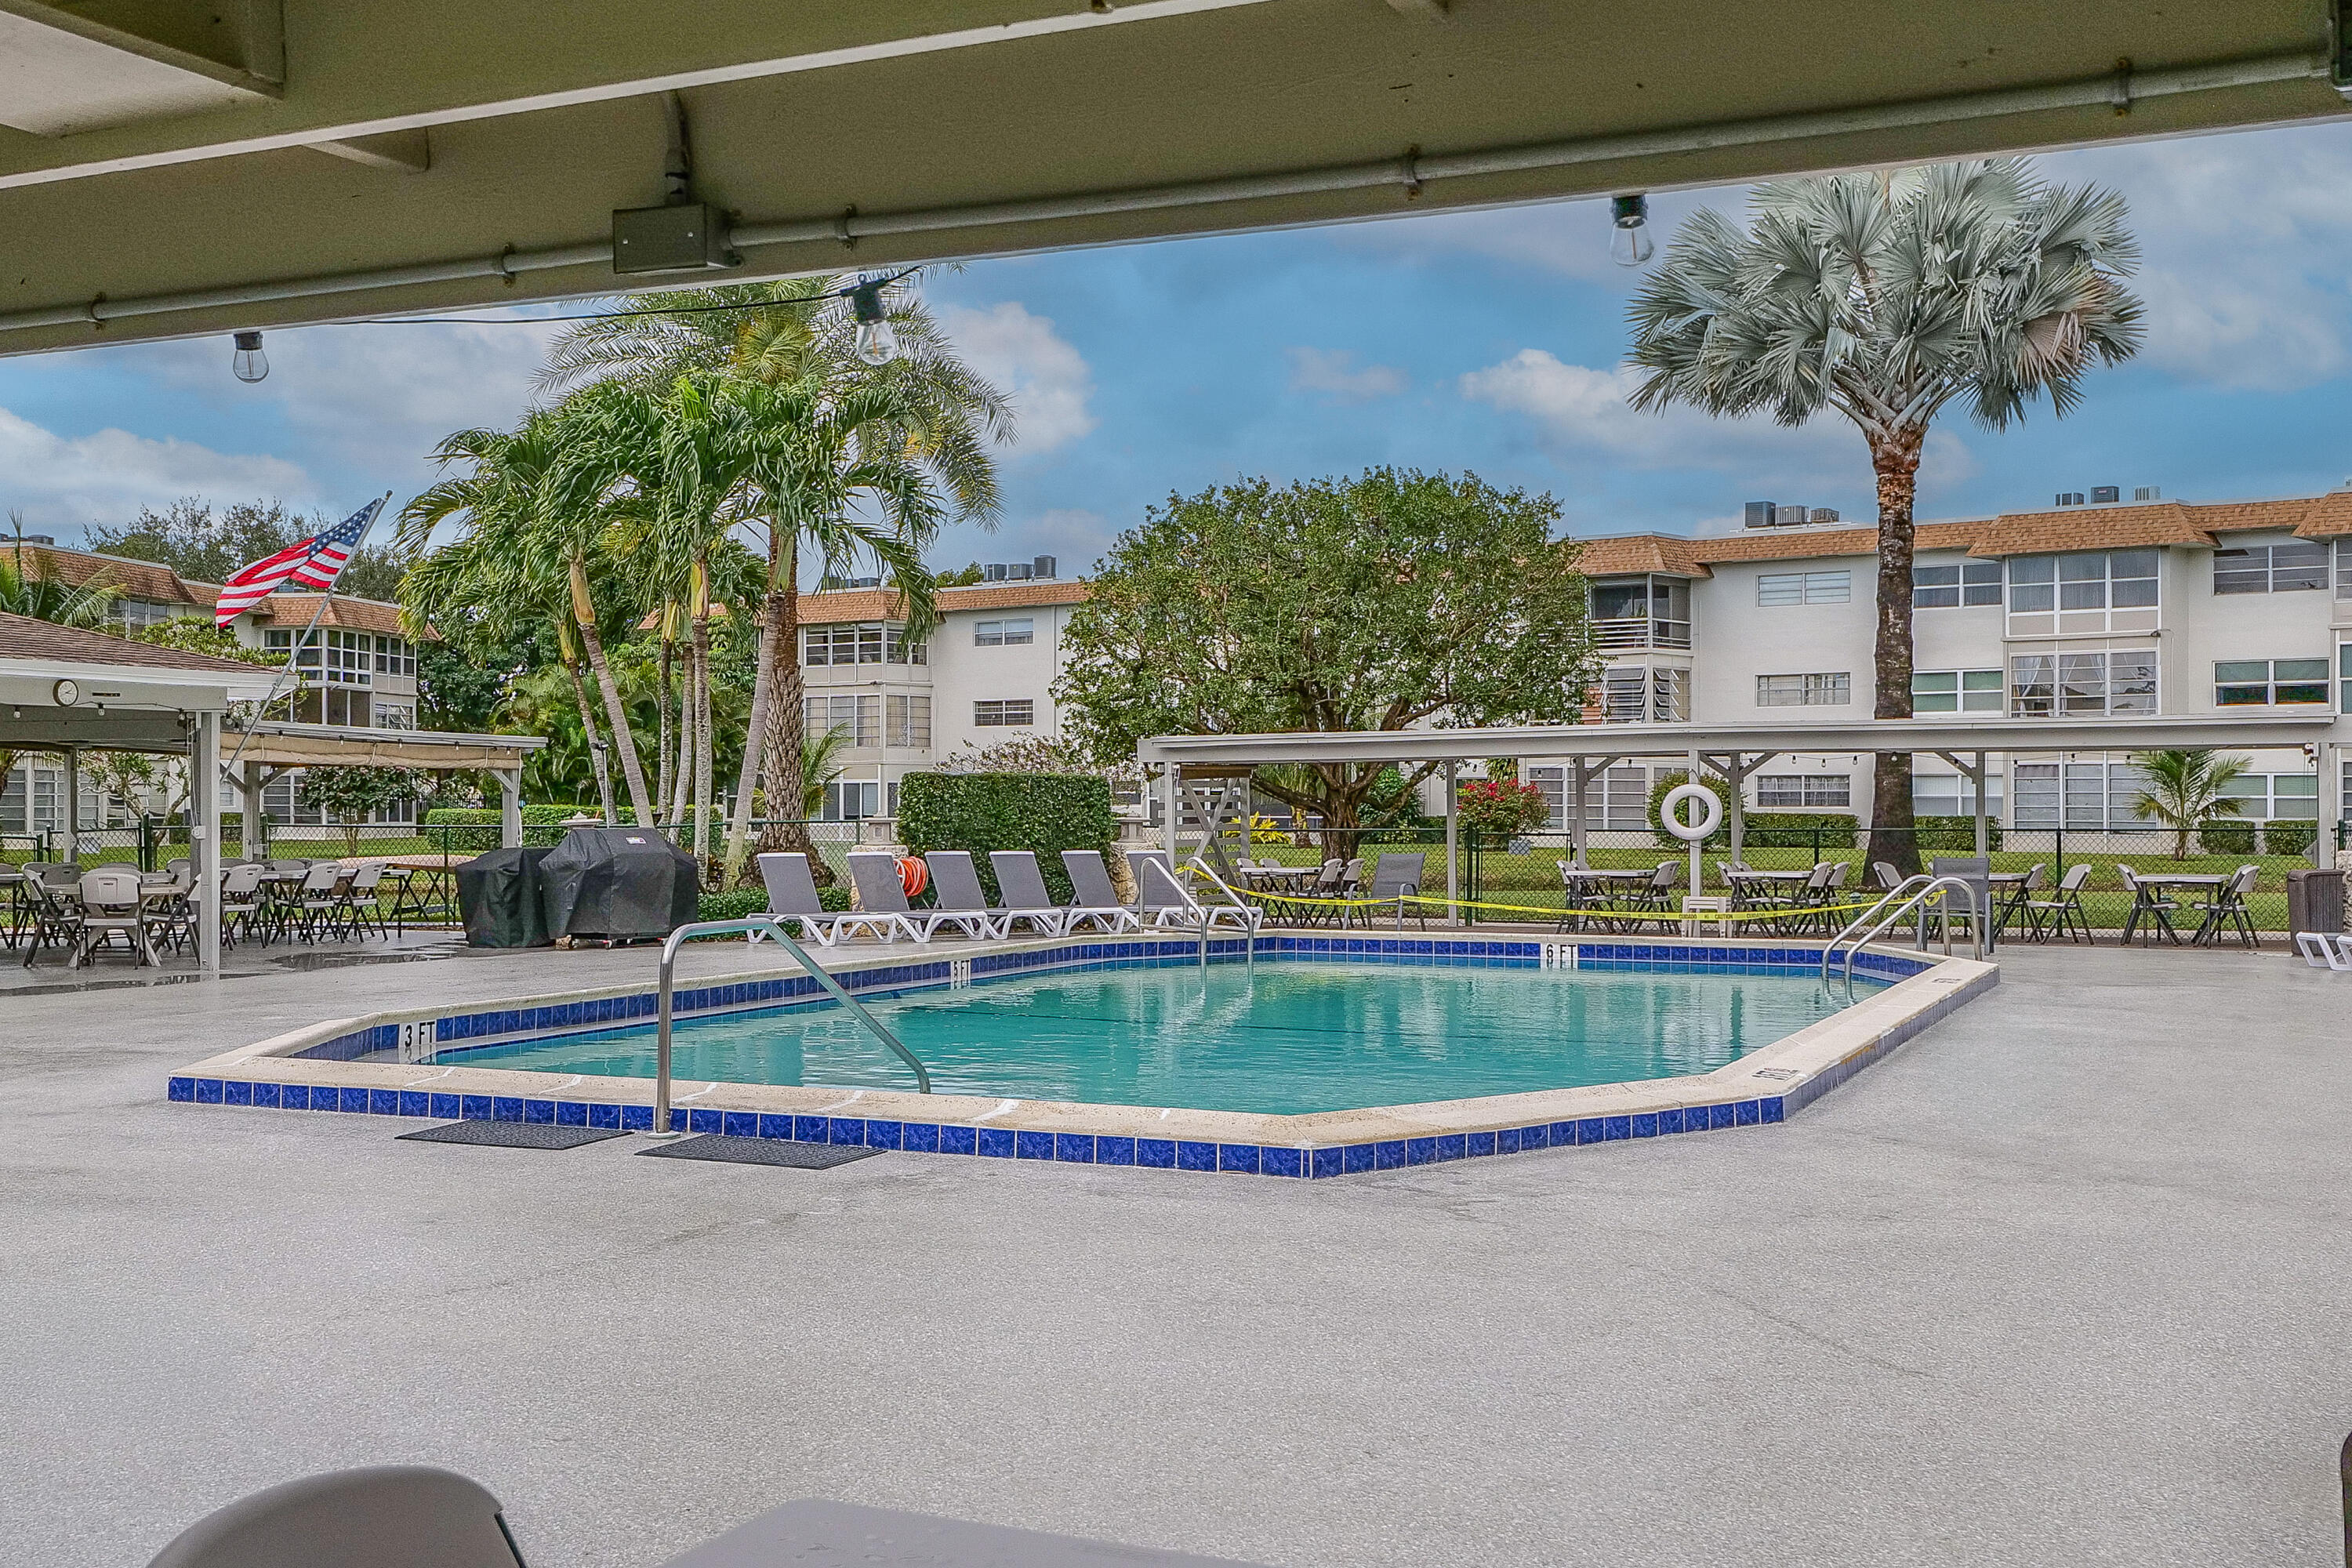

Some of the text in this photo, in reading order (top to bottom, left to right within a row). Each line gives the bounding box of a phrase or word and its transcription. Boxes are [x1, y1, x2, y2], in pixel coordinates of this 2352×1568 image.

[1546, 944, 1577, 958] 6 FT
[954, 960, 970, 976] 5 FT
[405, 1022, 435, 1047] 3 FT
